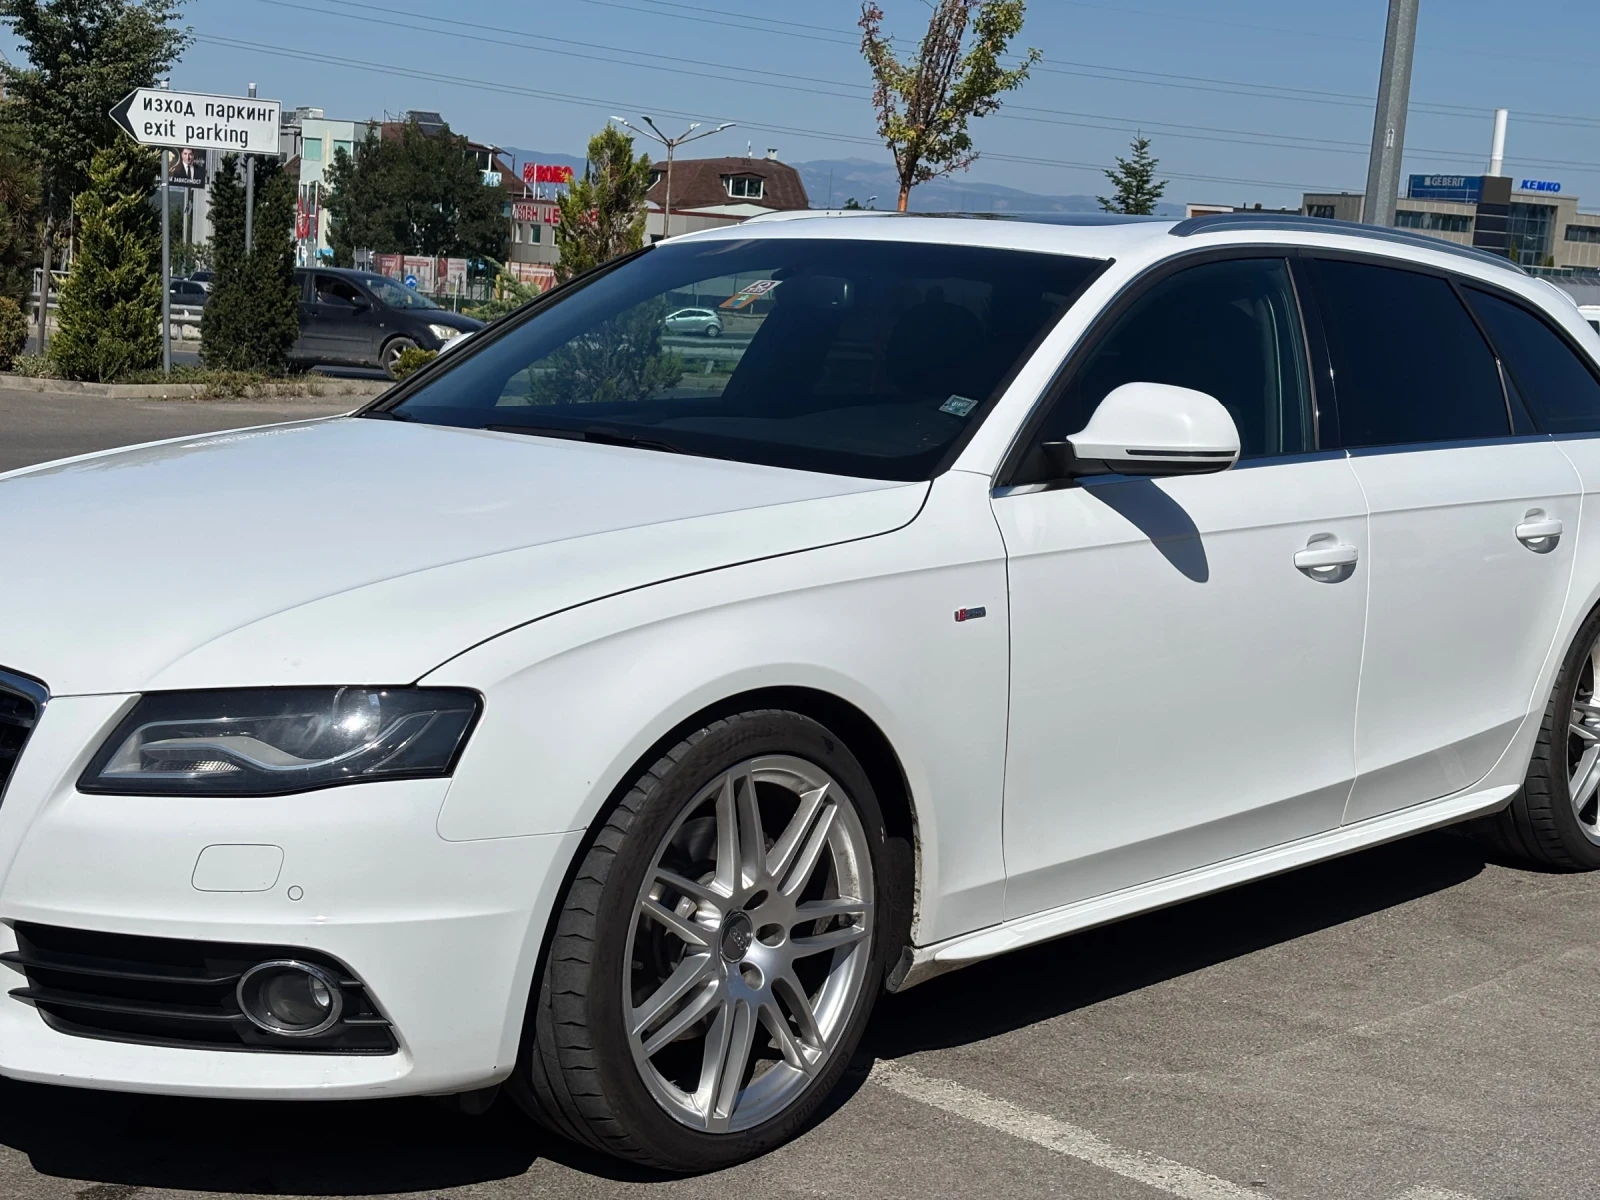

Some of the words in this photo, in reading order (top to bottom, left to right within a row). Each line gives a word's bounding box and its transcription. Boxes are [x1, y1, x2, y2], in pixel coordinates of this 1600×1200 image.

[143, 97, 195, 117] изход
[205, 103, 275, 123] паркинг
[144, 119, 176, 137] exit
[186, 123, 249, 148] parking
[1431, 177, 1465, 187] GEBERIT
[1521, 179, 1561, 192] KEMKO
